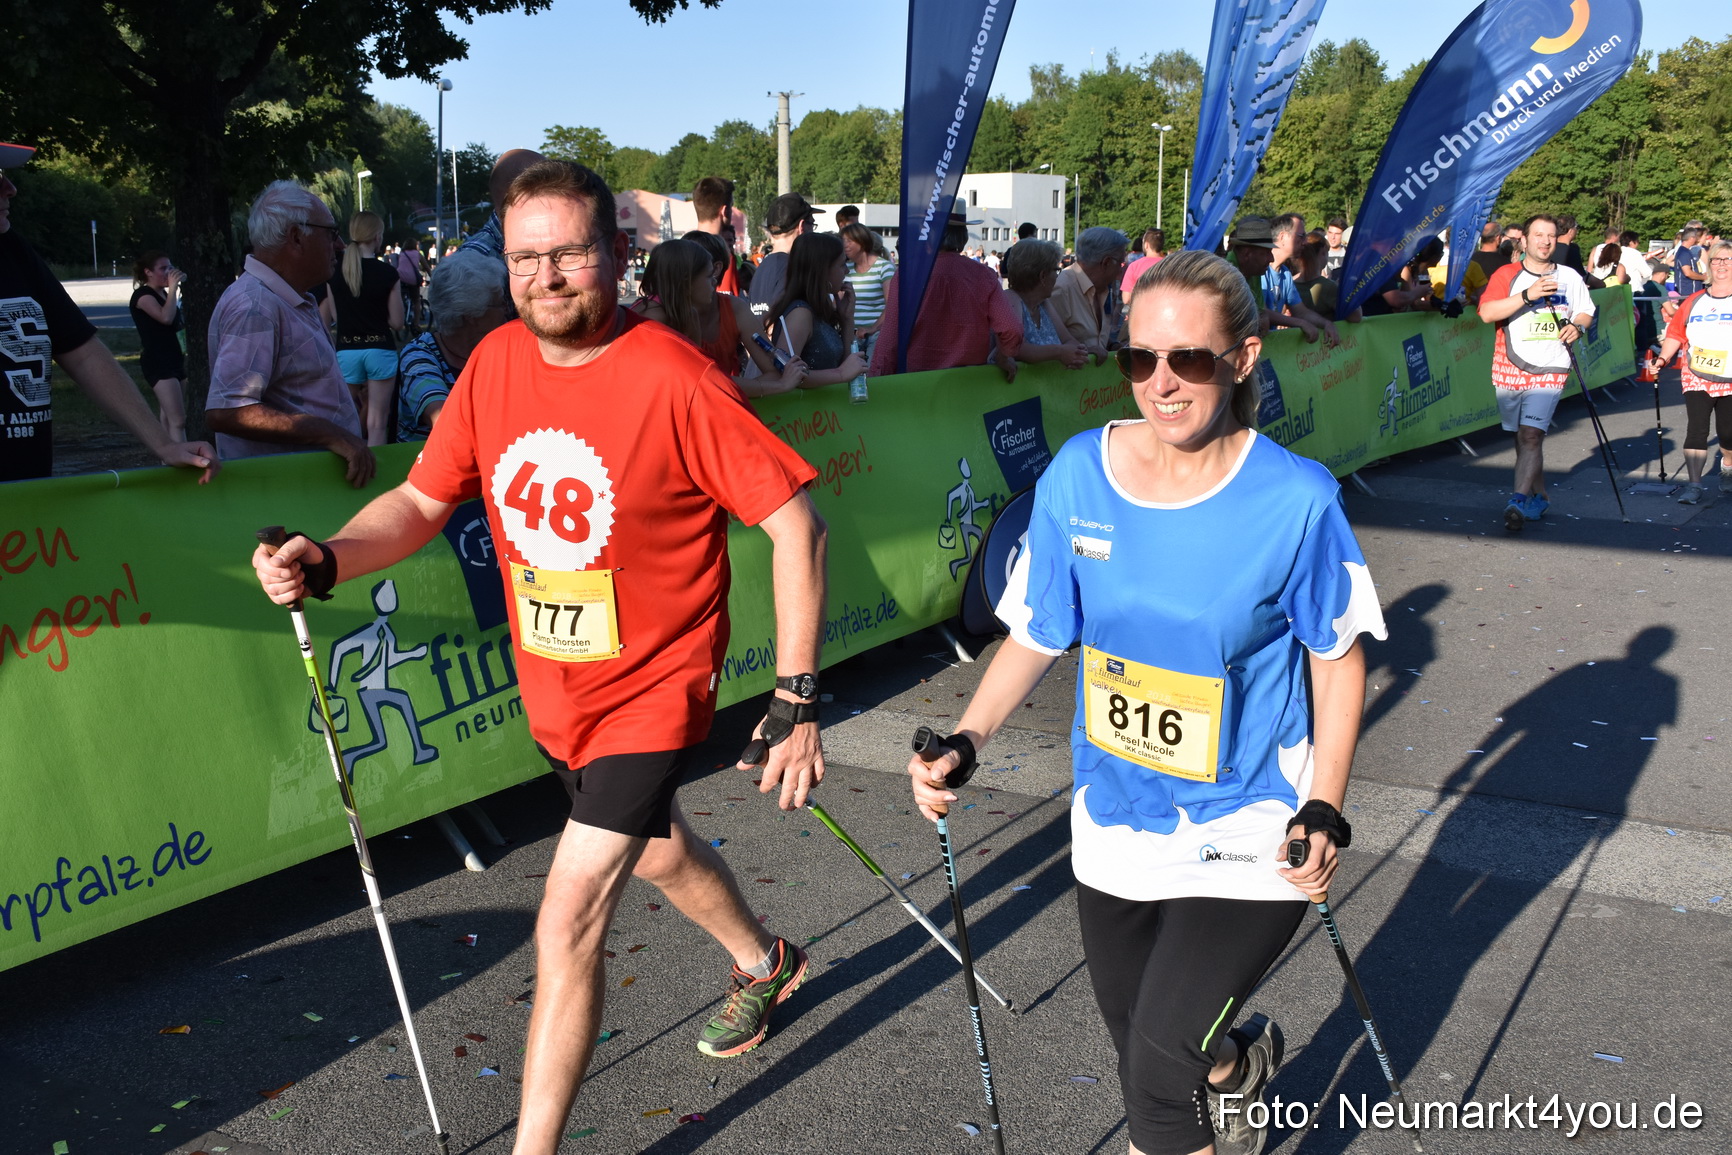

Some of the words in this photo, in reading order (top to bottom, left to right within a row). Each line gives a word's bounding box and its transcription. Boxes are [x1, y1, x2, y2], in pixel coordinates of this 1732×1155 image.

[1491, 106, 1536, 145] Druck
[1535, 80, 1564, 109] und
[1564, 33, 1622, 83] Medien
[1381, 62, 1554, 214] Frischmann
[1344, 203, 1446, 304] www.frischmann-net.de
[1695, 356, 1721, 368] 1742
[1401, 366, 1450, 418] firmenlauf
[10, 411, 52, 424] ALLSTA
[7, 426, 34, 438] 1986
[1001, 426, 1036, 450] Fischer
[1009, 441, 1036, 457] AUTOMOBILE
[528, 599, 584, 636] 777
[552, 636, 591, 646] Thorsten
[1099, 667, 1142, 688] firmenlauf
[1108, 693, 1183, 746] 816
[1114, 730, 1140, 747] Pesel
[1143, 738, 1175, 757] Nicole
[1124, 744, 1137, 755] IKK
[1138, 749, 1162, 762] classic
